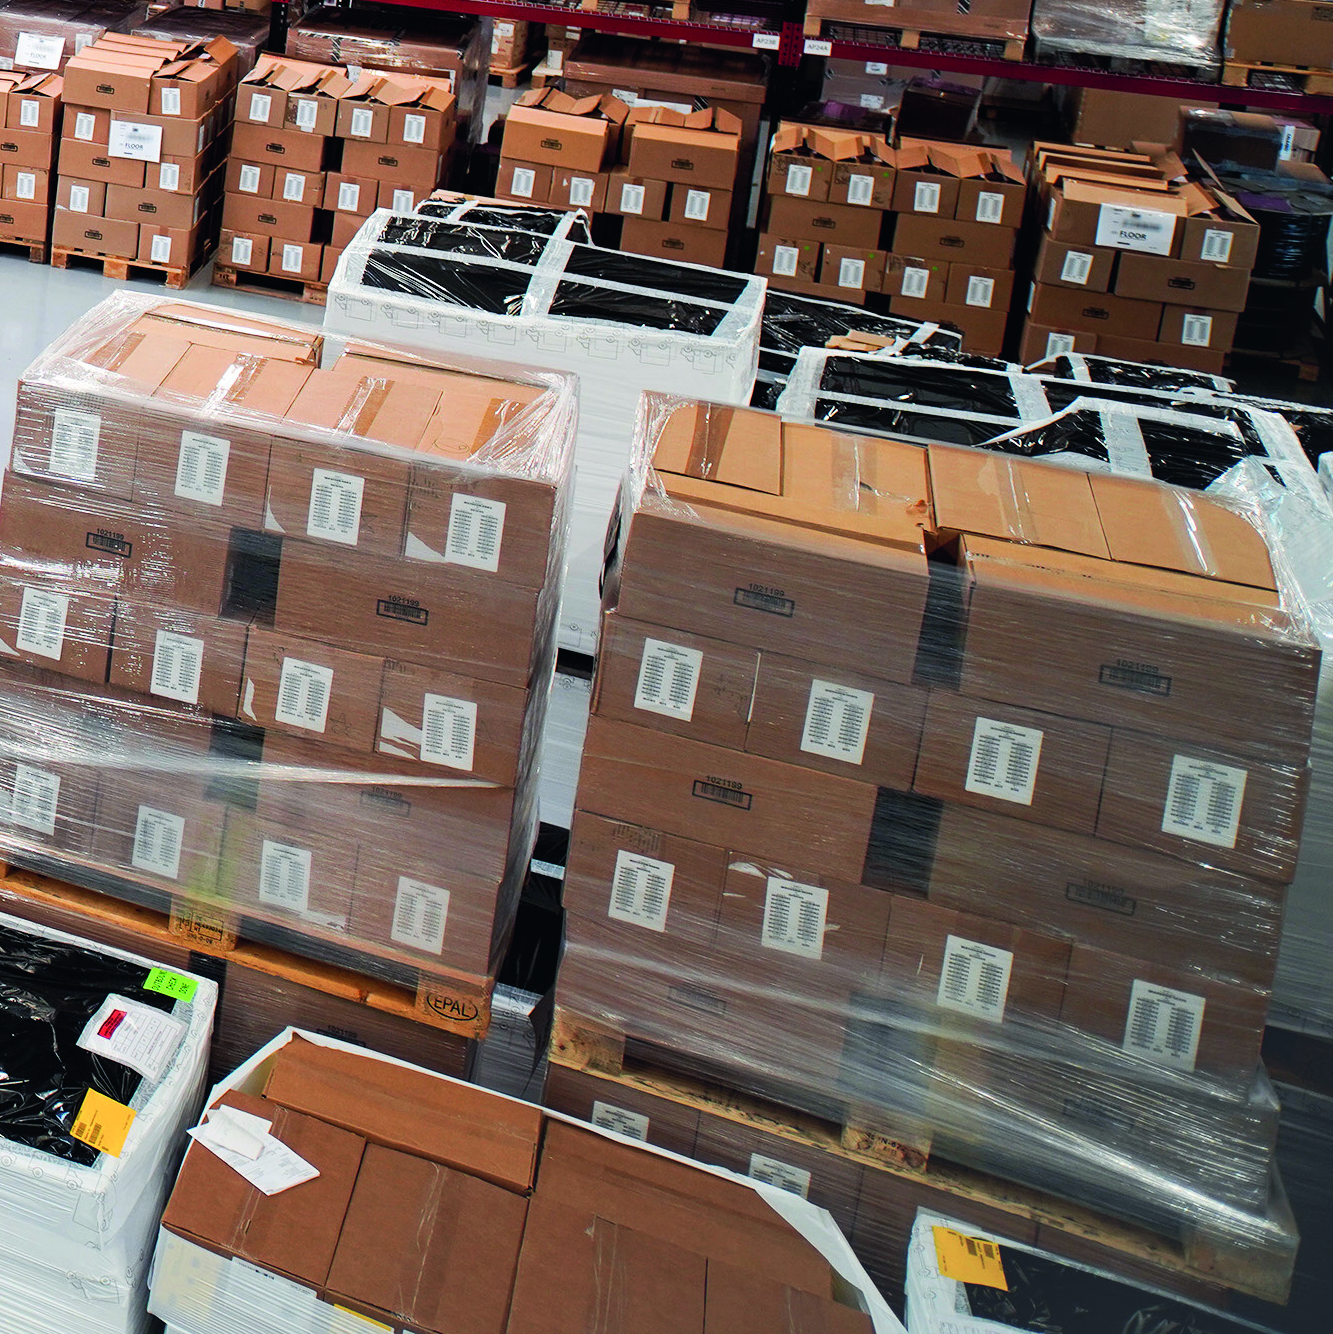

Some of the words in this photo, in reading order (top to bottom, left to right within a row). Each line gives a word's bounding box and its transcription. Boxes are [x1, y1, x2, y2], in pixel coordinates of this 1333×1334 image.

[124, 141, 144, 150] FLOOR
[1119, 230, 1148, 240] FLOOR
[96, 527, 125, 540] 1021199
[748, 584, 785, 597] 1021199
[387, 594, 420, 607] 1021199
[705, 775, 743, 791] 1021199
[434, 996, 467, 1016] EPAL
